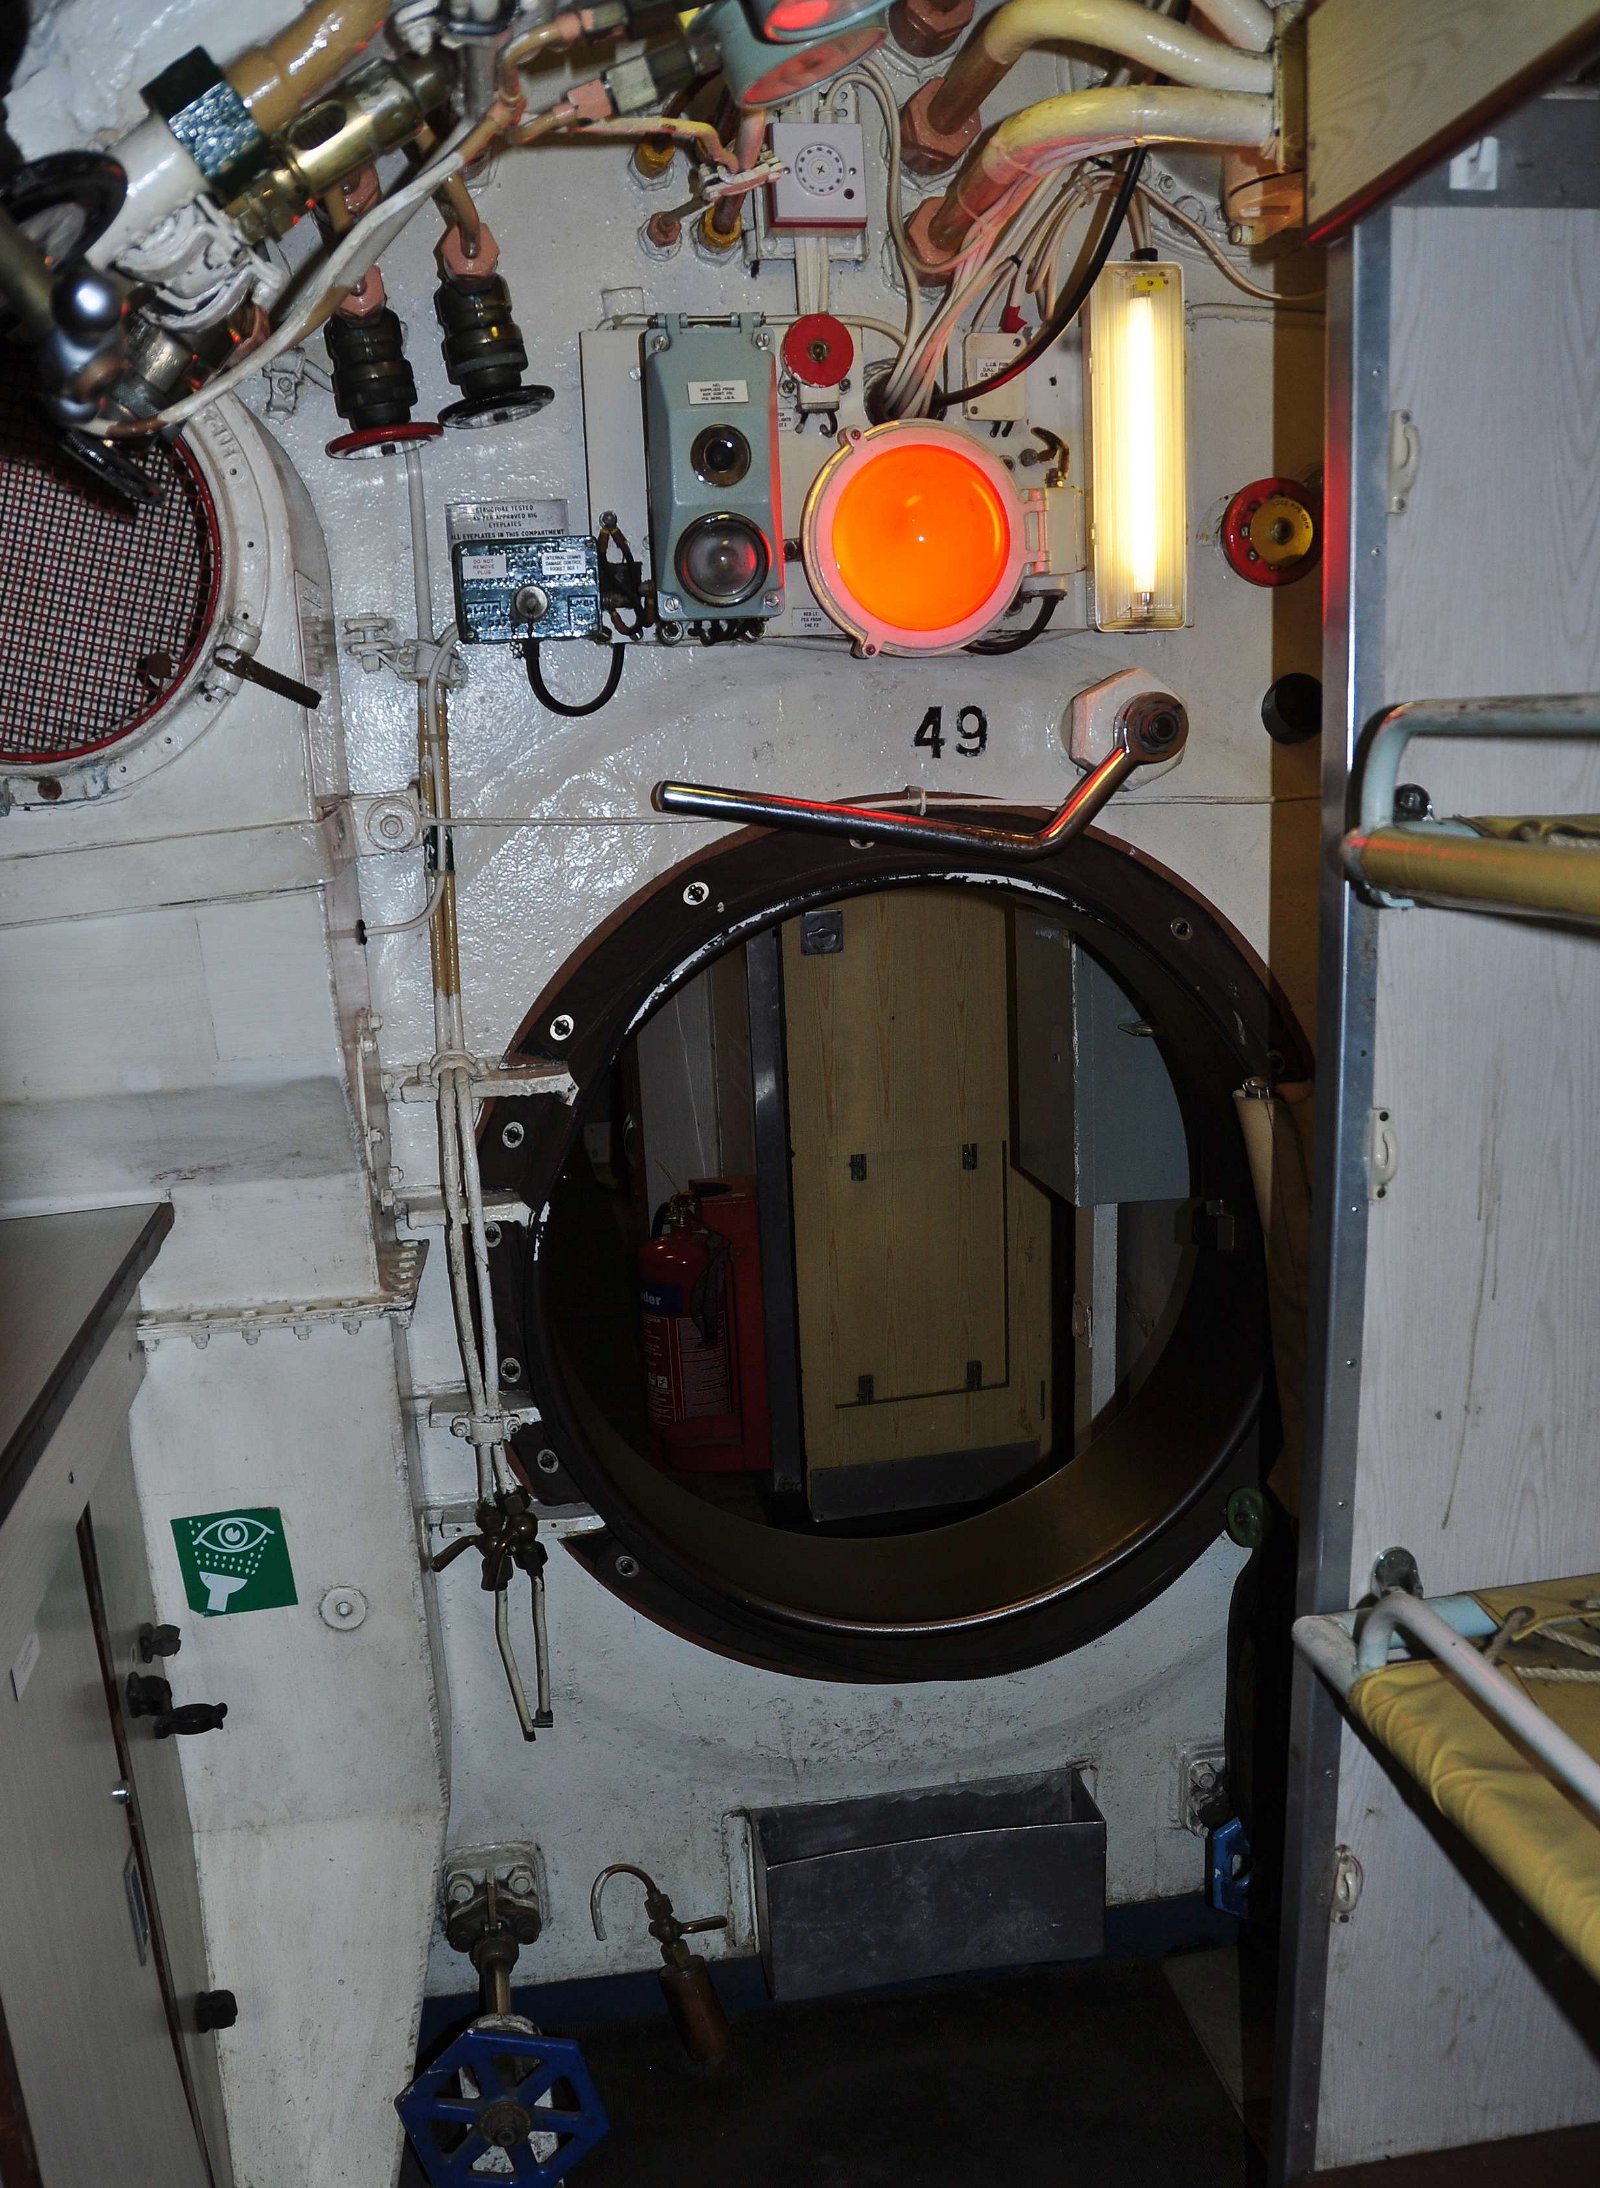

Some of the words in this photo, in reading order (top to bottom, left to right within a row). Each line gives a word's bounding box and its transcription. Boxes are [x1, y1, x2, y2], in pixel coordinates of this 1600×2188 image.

[511, 504, 534, 512] TESTED
[488, 521, 522, 529] EYEPLATES
[463, 532, 496, 540] EYEPLATES
[521, 528, 565, 537] COMPARTMENT
[914, 705, 988, 758] 49
